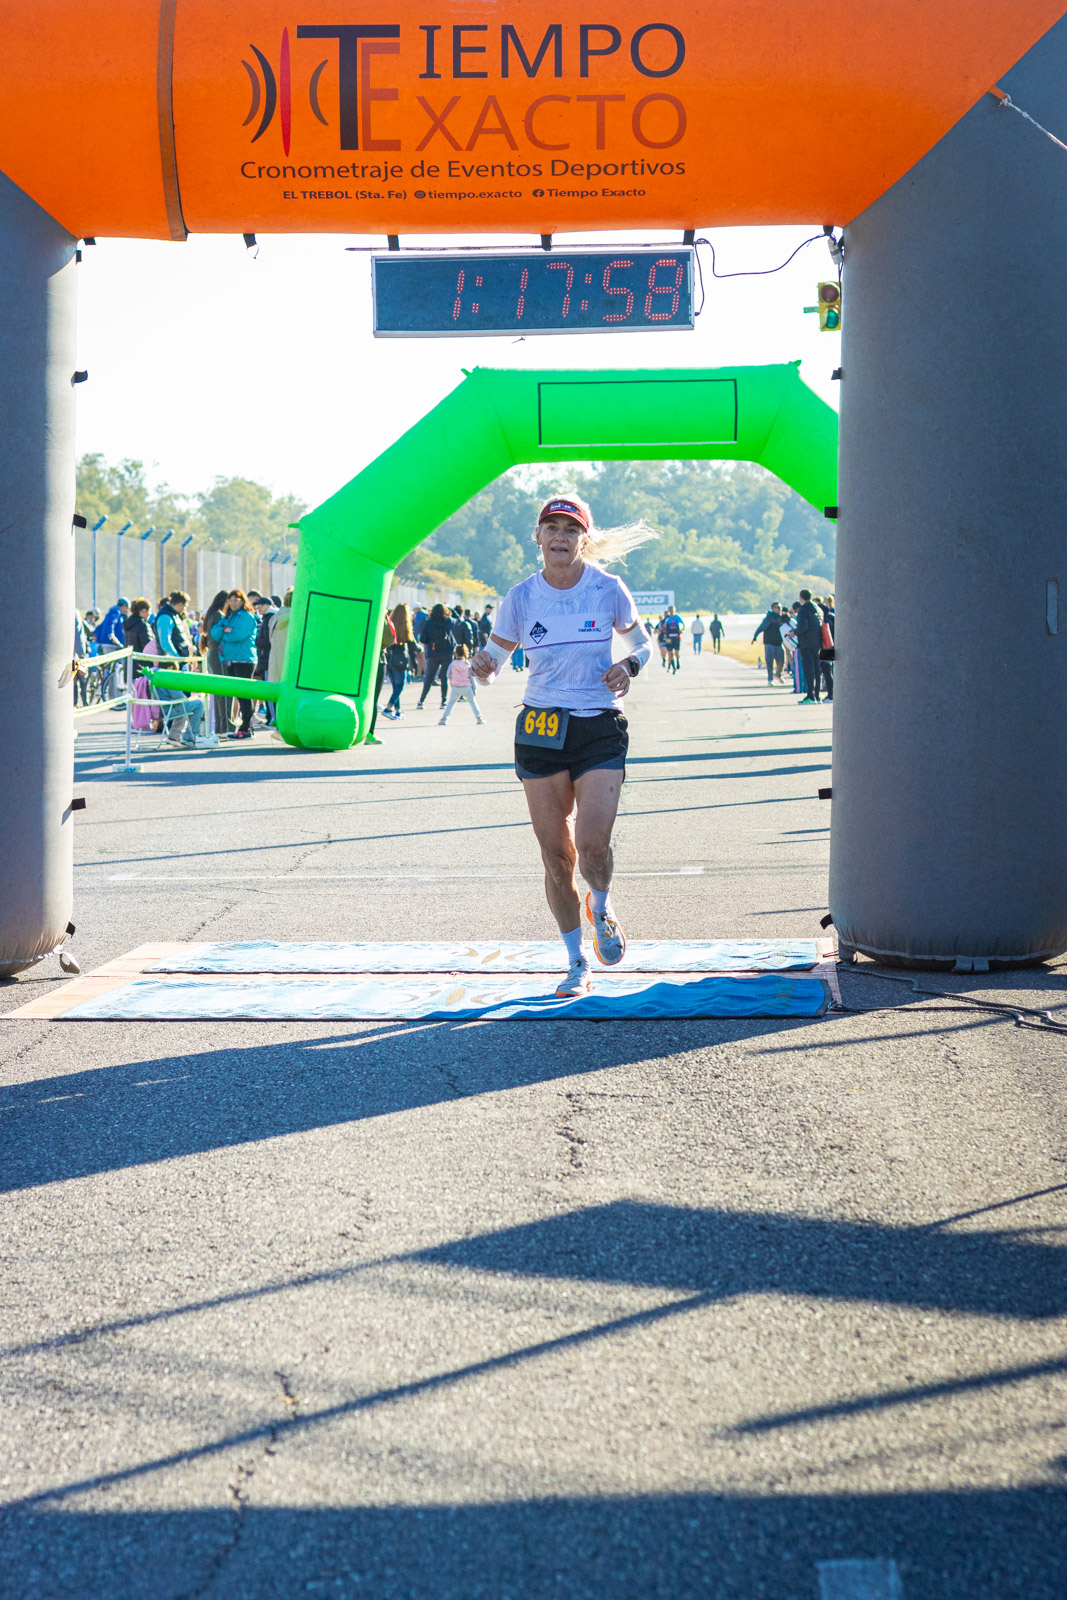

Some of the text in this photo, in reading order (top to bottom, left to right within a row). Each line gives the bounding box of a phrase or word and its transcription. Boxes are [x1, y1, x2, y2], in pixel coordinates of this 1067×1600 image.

[240, 158, 686, 182] Cronometraje de Eventos Deportivos
[283, 189, 408, 201] EL TREBOL (Sta. Fe)
[428, 189, 523, 202] tiempo.exacto
[546, 187, 646, 199] Tiempo Exacto
[524, 710, 559, 737] 649
